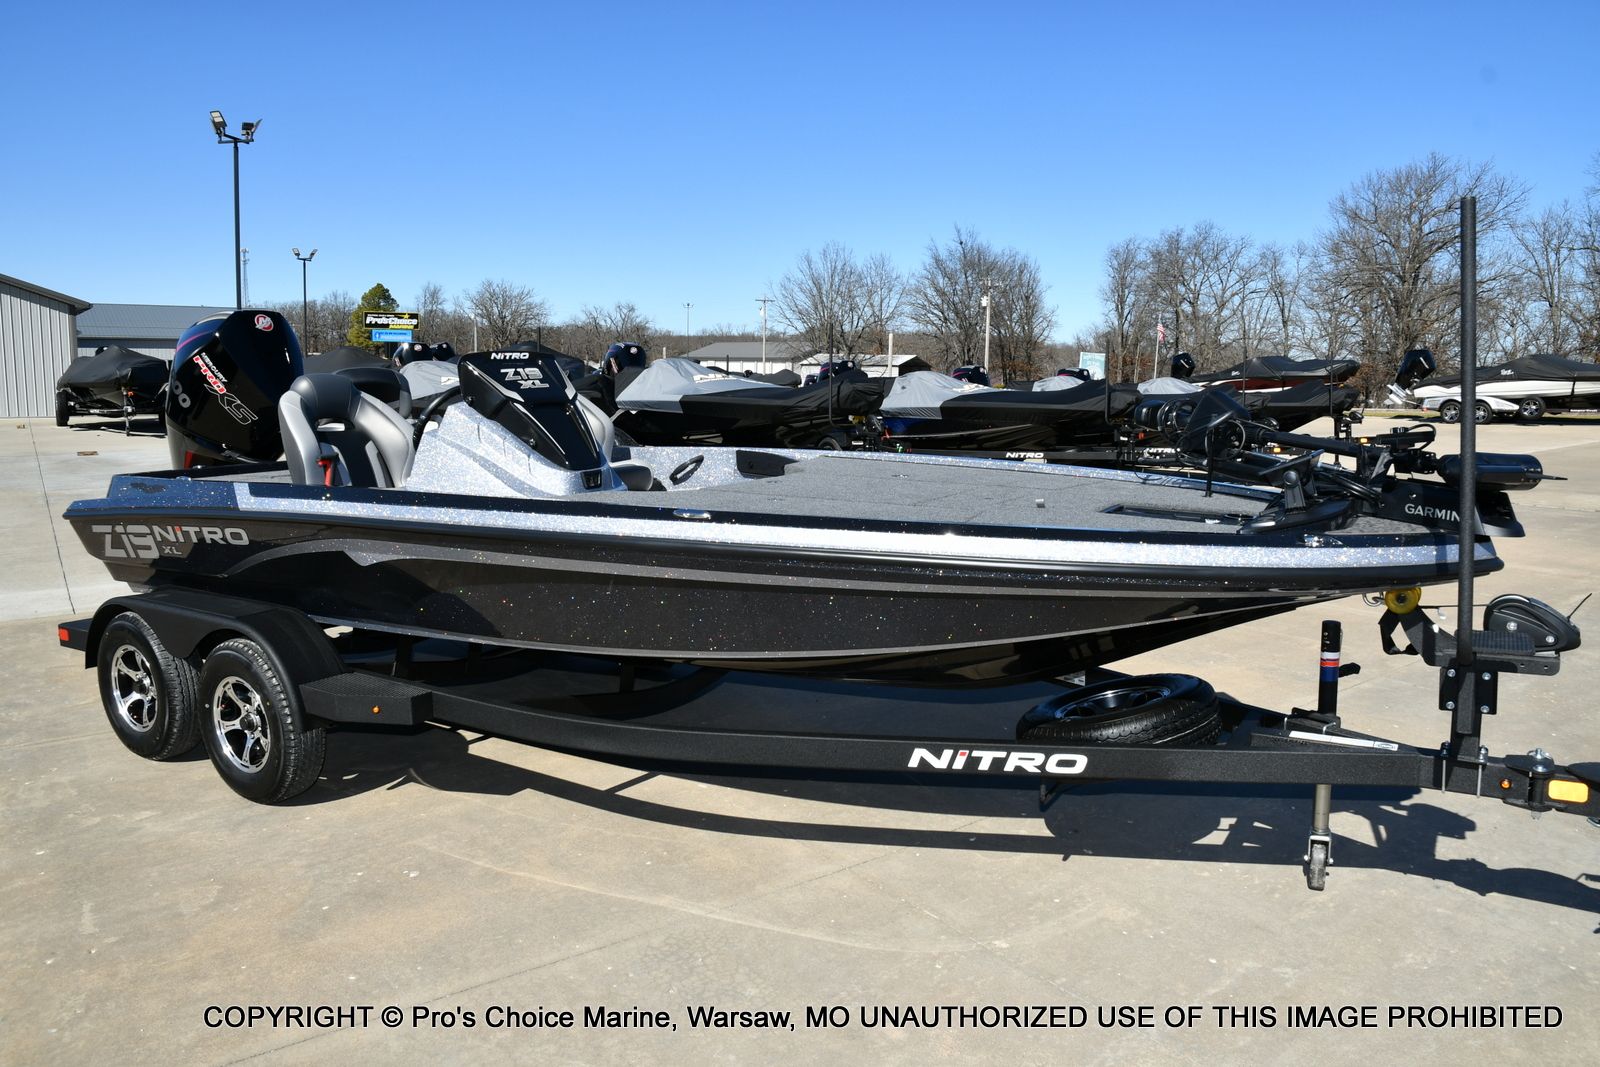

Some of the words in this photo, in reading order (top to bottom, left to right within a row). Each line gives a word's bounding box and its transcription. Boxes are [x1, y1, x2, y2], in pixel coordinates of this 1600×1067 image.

[490, 352, 530, 360] NITRO
[193, 355, 227, 394] PRO
[200, 352, 228, 382] MERCURY
[1005, 451, 1045, 459] NITRO
[1404, 503, 1461, 522] GARMIN
[151, 525, 250, 546] NITRO
[162, 545, 183, 555] XL
[907, 747, 1089, 775] NITRO
